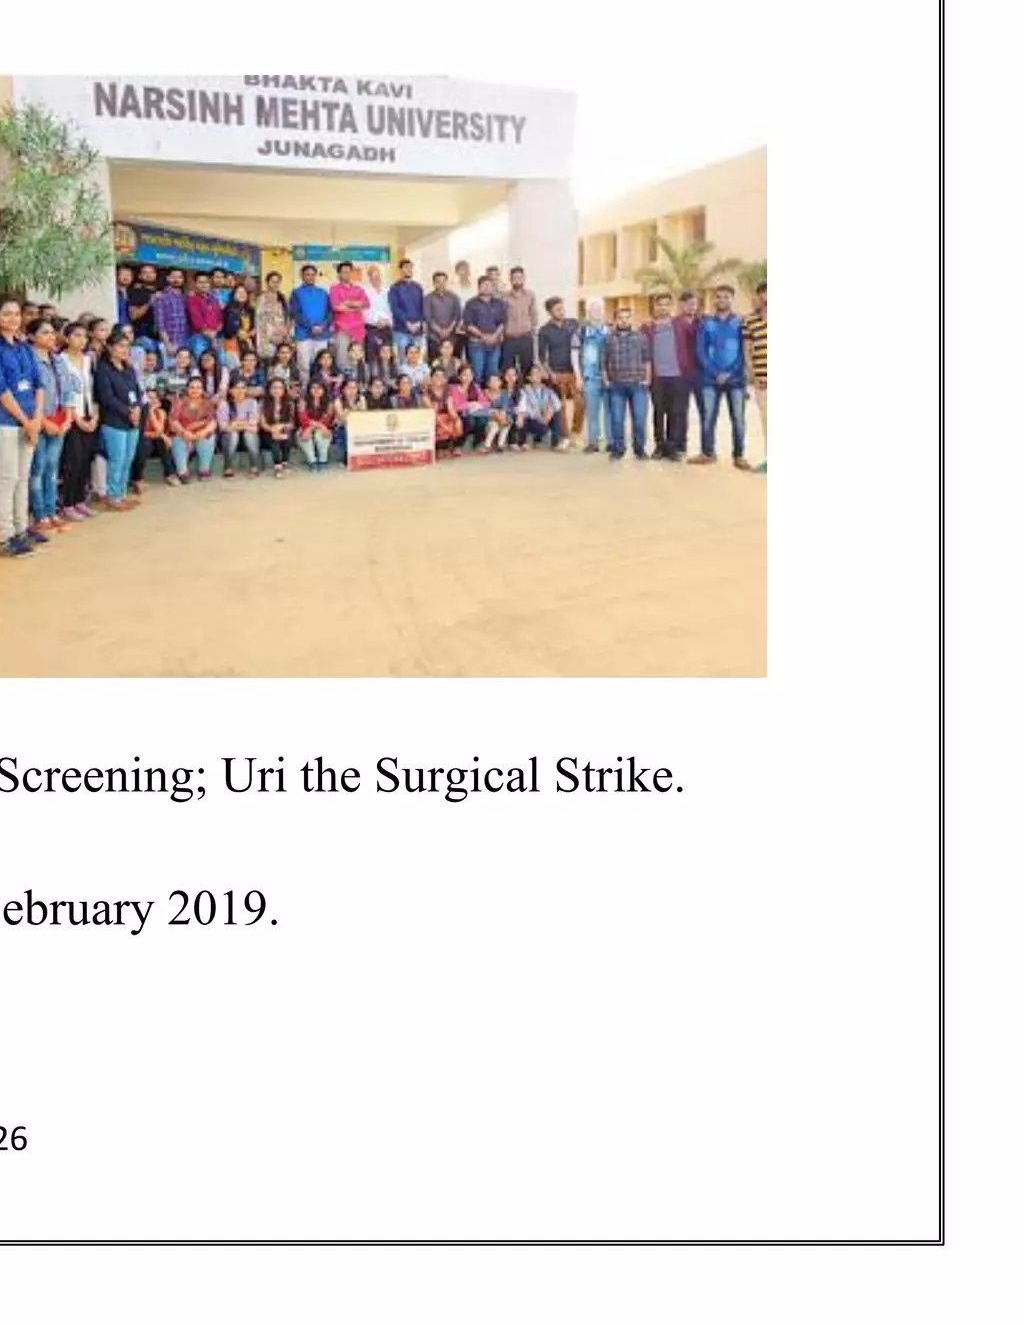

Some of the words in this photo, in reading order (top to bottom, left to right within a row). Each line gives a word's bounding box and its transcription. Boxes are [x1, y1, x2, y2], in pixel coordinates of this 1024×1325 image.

[244, 75, 348, 95] BHAKTA
[357, 80, 413, 99] KAVI
[94, 82, 244, 125] NARSINH
[256, 95, 358, 133] MEHTA
[367, 104, 526, 144] UNIVERSITY
[257, 140, 396, 162] JUNAGADH
[221, 757, 286, 792] Uri
[301, 756, 360, 792] the
[377, 757, 540, 802] Surgical
[557, 757, 684, 792] Strike.
[168, 890, 278, 925] 2019.
